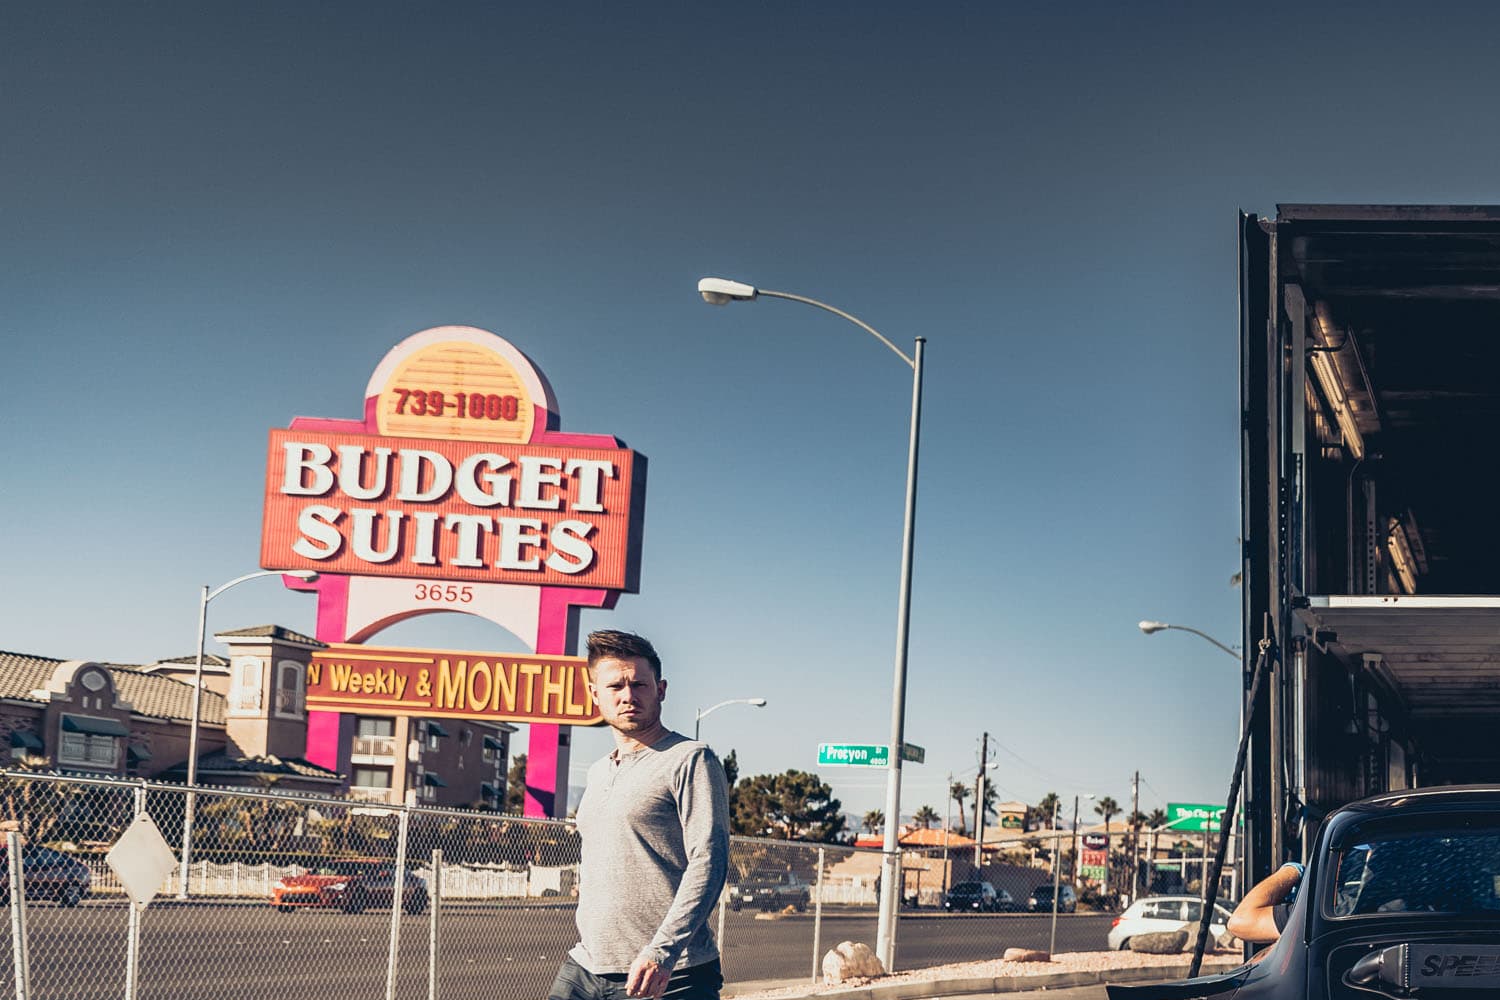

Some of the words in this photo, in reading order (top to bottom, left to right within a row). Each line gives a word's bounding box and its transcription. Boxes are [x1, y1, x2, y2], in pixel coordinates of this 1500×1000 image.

[393, 387, 518, 421] 739-1000
[280, 441, 614, 513] BUDGET
[292, 504, 594, 574] SUITES
[414, 583, 474, 604] 3655
[329, 664, 407, 701] Weekly
[416, 668, 432, 697] &
[436, 658, 594, 716] MONTHLY
[827, 746, 867, 762] Procyon
